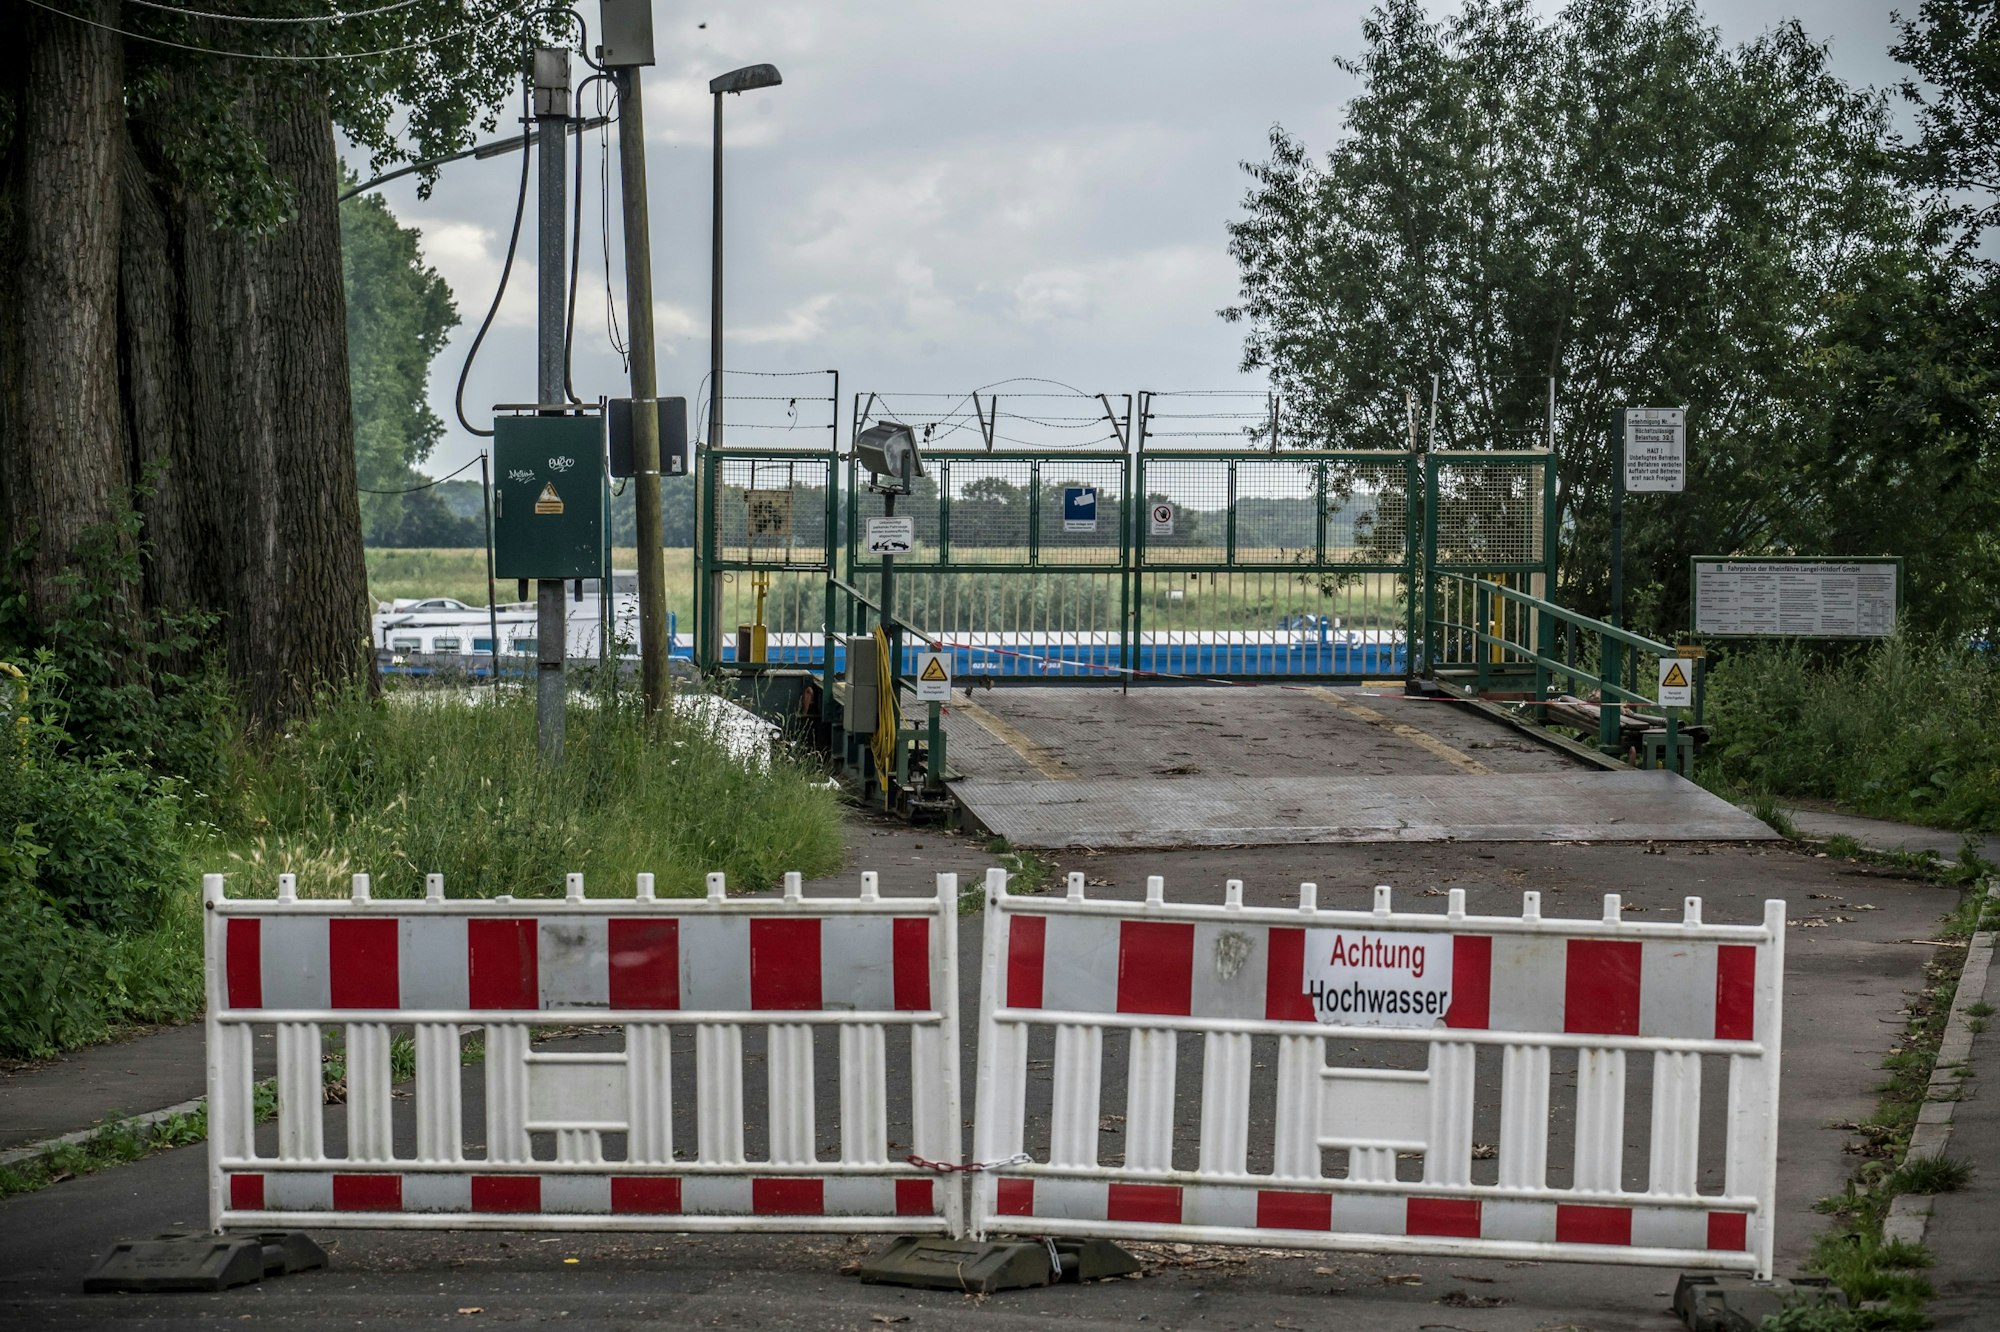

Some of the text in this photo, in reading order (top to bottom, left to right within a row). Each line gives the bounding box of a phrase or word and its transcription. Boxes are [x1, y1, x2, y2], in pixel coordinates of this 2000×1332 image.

[1727, 564, 1757, 572] Fahrpreise
[1768, 564, 1799, 572] Rheinfähre
[1800, 565, 1841, 573] Langel-Hitdorf
[1330, 934, 1425, 978] Achtung
[1310, 979, 1448, 1014] Hochwasser
